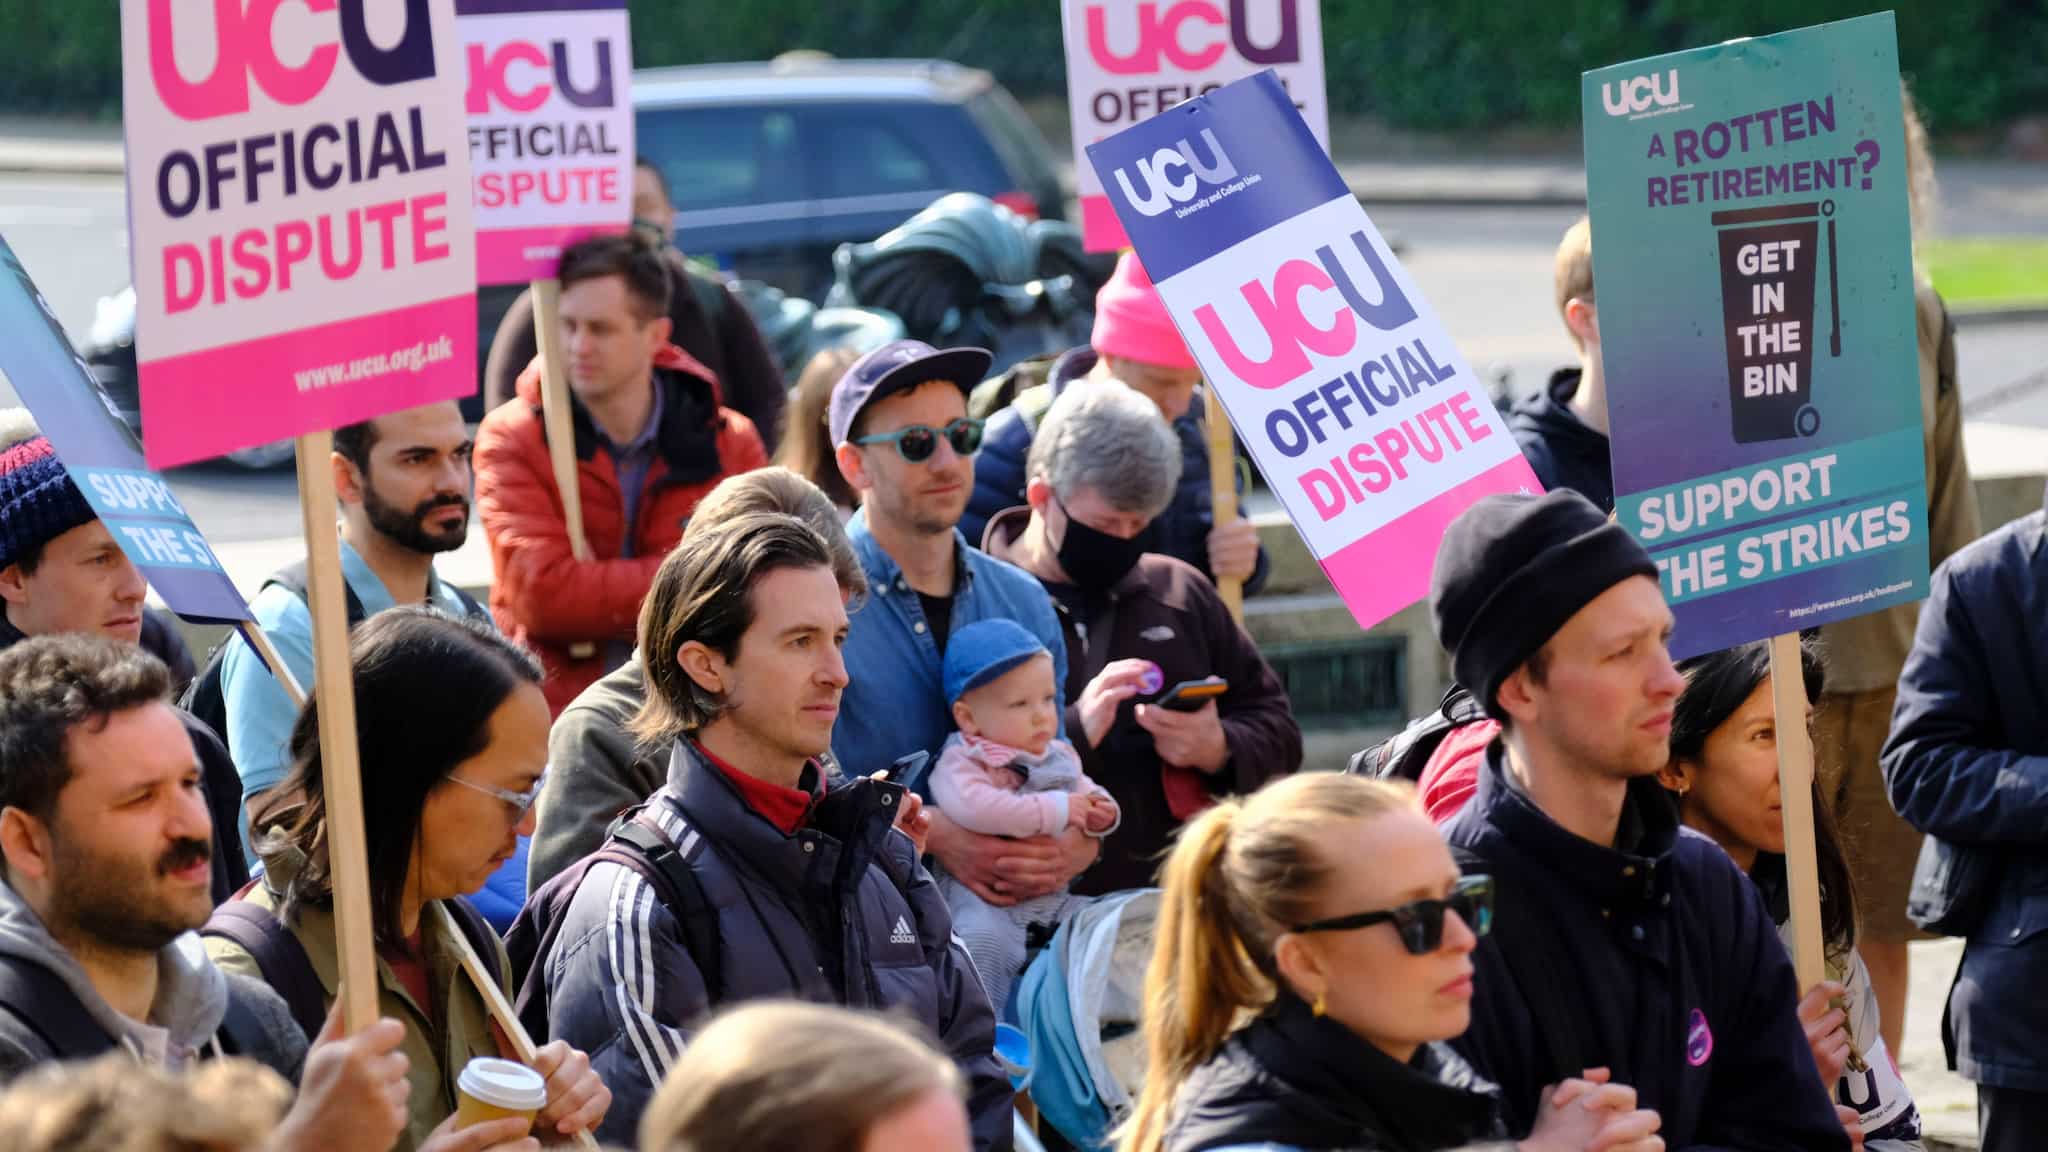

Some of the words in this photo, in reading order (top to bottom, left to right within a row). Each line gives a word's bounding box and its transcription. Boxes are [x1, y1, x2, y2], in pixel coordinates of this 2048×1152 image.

[1602, 69, 1680, 117] UCU
[157, 106, 446, 219] OFFICIAL
[1647, 133, 1666, 159] A
[1673, 95, 1836, 168] ROTTEN
[472, 167, 619, 209] SPUTE
[1113, 127, 1239, 217] UCU
[1647, 139, 1881, 208] RETIREMENT?
[162, 191, 450, 315] DISPUTE
[1736, 239, 1801, 276] GET
[1192, 230, 1419, 390] UCU
[1752, 281, 1785, 316] IN
[293, 334, 453, 392] www.ucu.org.uk
[1736, 320, 1801, 357] THE
[1264, 339, 1456, 459] OFFICIAL
[1743, 361, 1798, 398] BIN
[1297, 390, 1493, 522] DISPUTE
[1638, 453, 1837, 540] SUPPORT
[120, 526, 192, 563] THE
[1738, 500, 1911, 580] STRIKES
